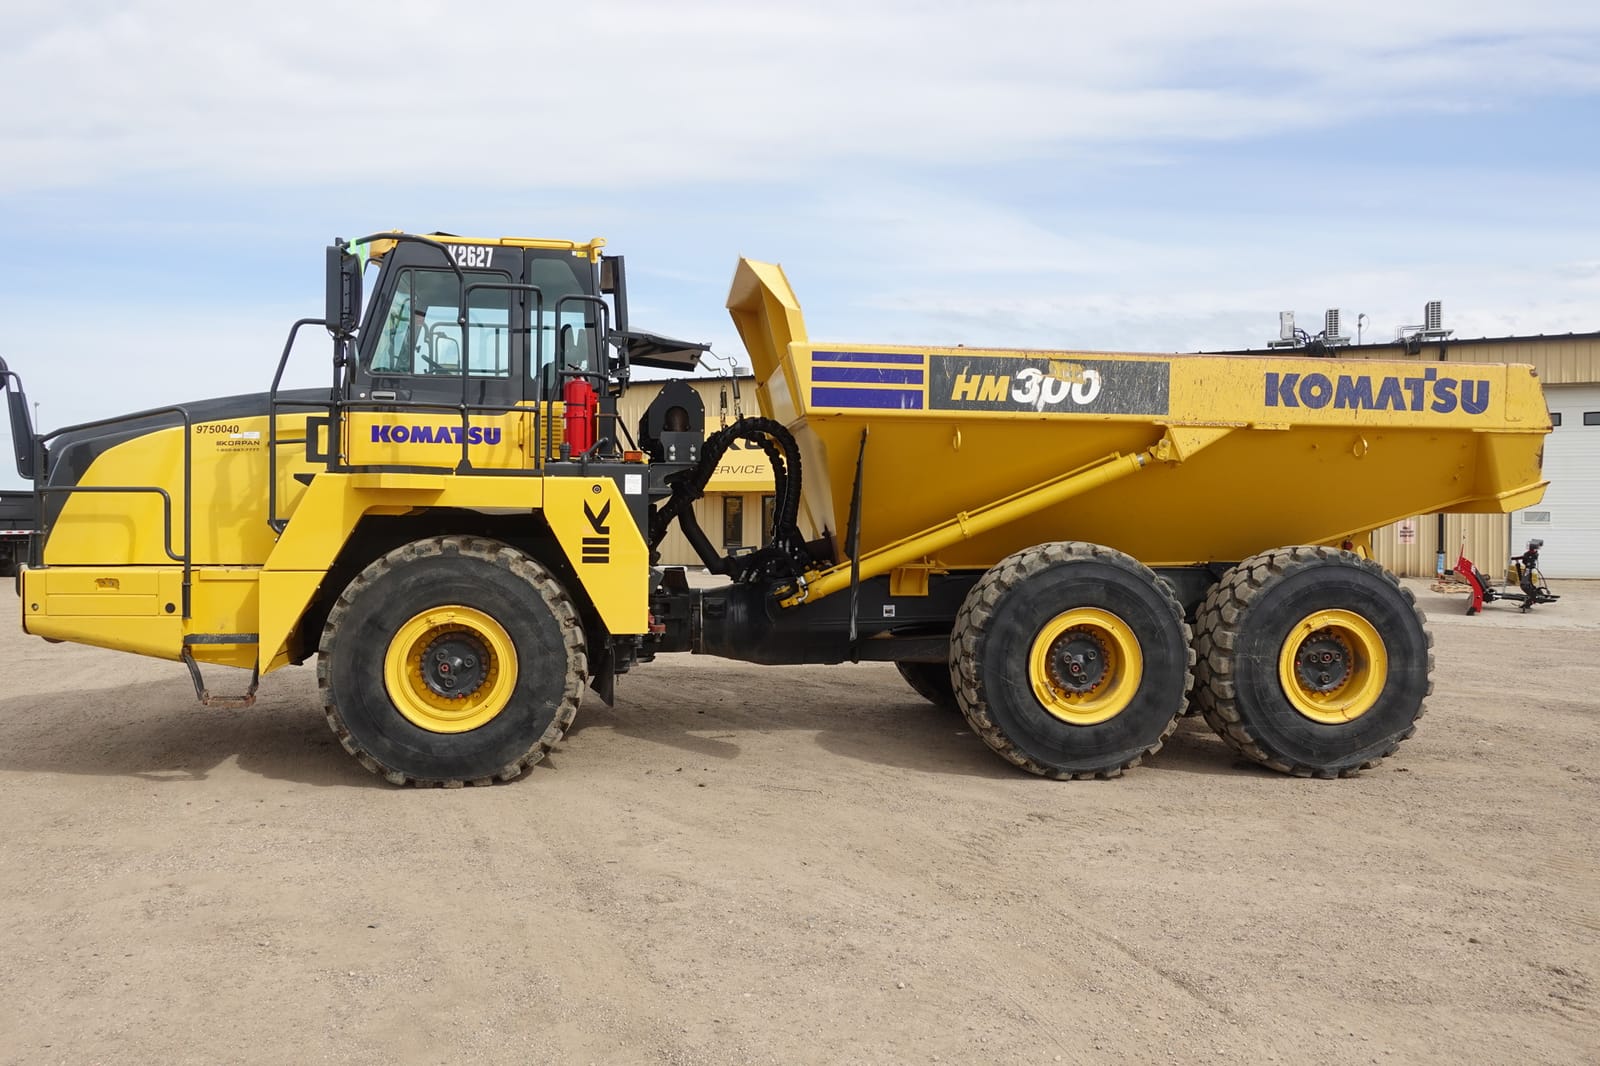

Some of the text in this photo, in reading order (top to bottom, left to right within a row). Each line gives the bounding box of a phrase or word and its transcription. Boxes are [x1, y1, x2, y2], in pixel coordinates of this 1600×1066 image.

[447, 245, 494, 268] K2627
[1264, 367, 1490, 415] KOMATSU
[196, 424, 240, 434] 9750040
[370, 424, 502, 446] KOMATSU
